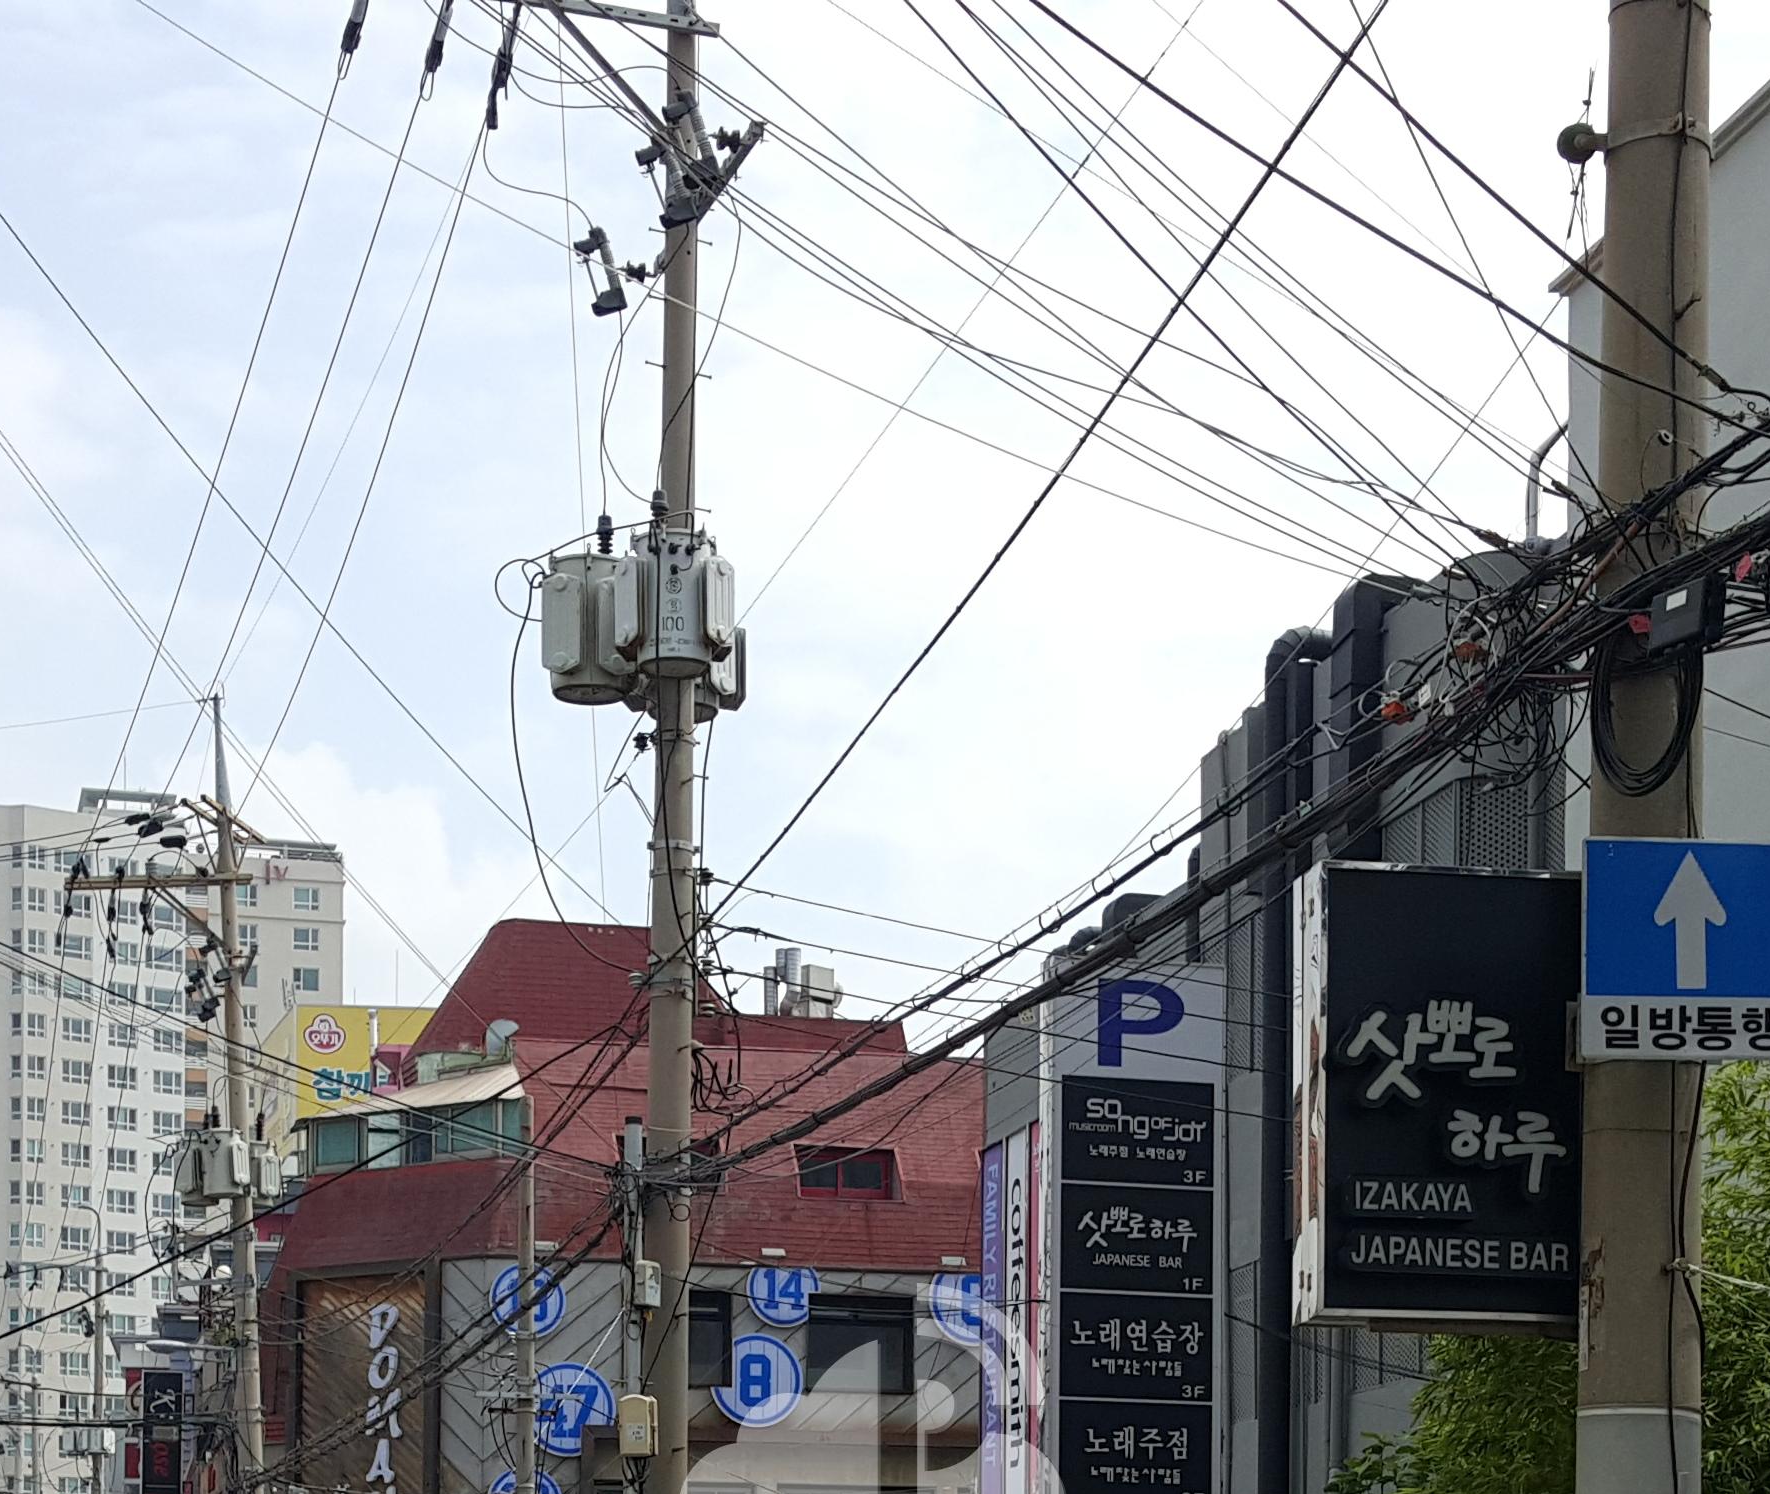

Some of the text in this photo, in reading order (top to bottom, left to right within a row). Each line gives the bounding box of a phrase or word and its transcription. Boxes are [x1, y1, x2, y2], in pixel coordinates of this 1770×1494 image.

[661, 616, 685, 632] 100
[311, 1032, 340, 1046] 오뚜기
[1097, 978, 1185, 1067] P
[1346, 999, 1518, 1100] 삿뽀로
[1447, 1109, 1568, 1195] 하루
[1183, 1169, 1207, 1184] 3F
[1354, 1180, 1472, 1213] IZAKAYA
[1092, 1252, 1183, 1269] JAPANESE BAR
[1351, 1235, 1569, 1272] JAPANESE BAR
[762, 1267, 806, 1311] 14
[1182, 1277, 1204, 1291] 1F
[982, 1163, 999, 1468] FAMILY RESTAURANT
[1010, 1177, 1024, 1468] coffeesmith
[1070, 1318, 1204, 1355] 노래연습장
[739, 1354, 772, 1408] 8
[1091, 1357, 1182, 1377] 노래찾는사람들
[1181, 1384, 1205, 1398] 3F
[1083, 1425, 1189, 1461] 노래주점
[1090, 1465, 1181, 1485] 노래찾는사람들
